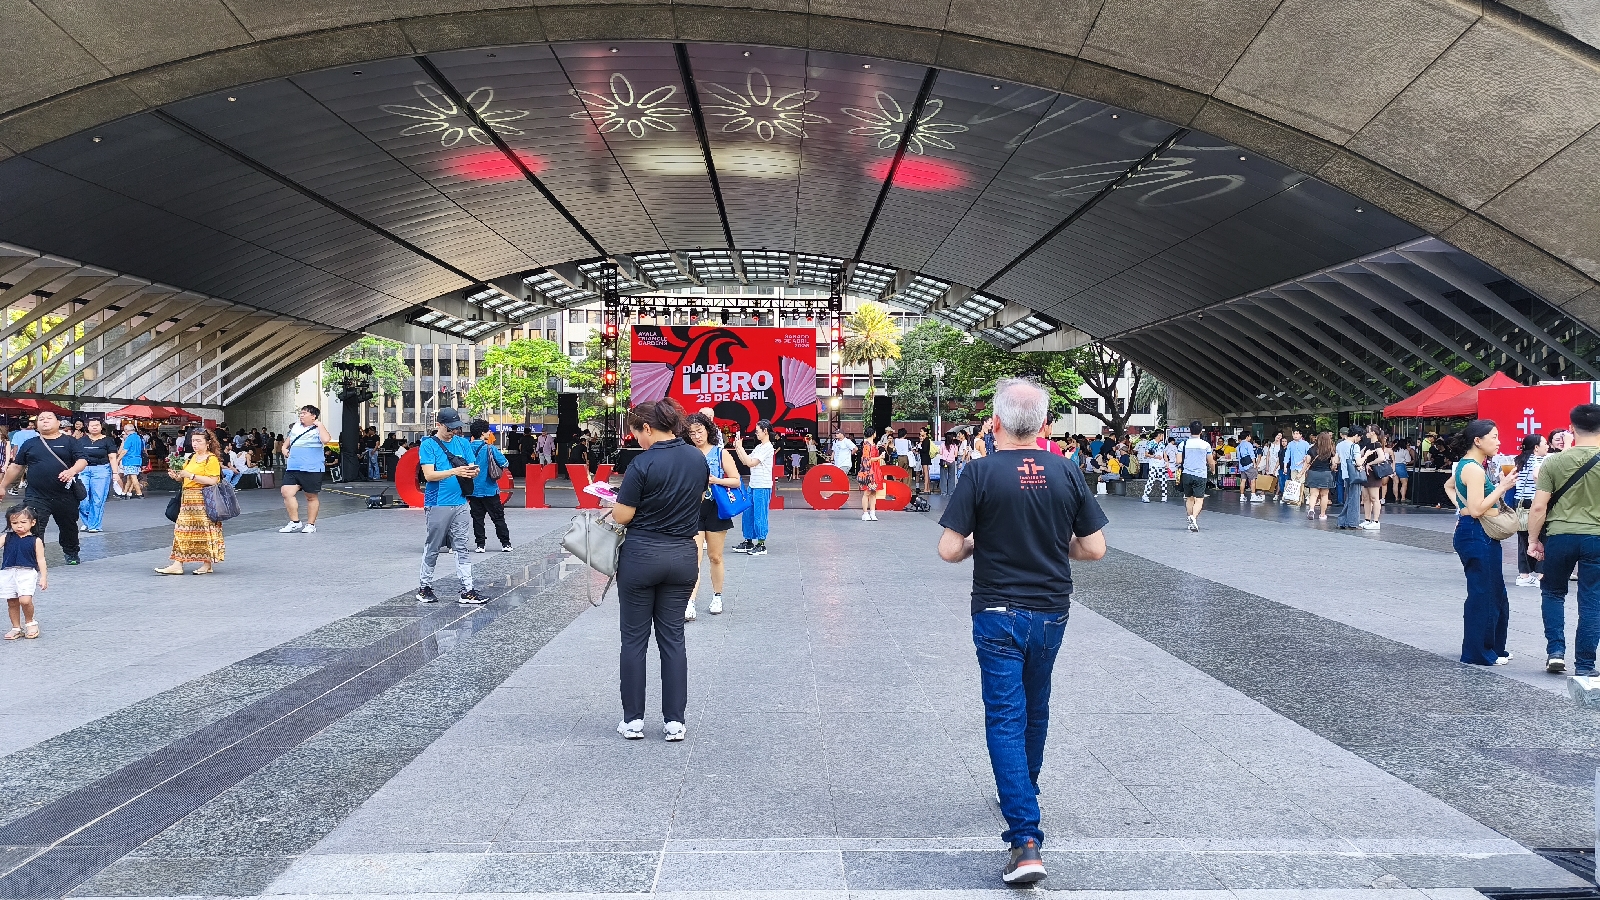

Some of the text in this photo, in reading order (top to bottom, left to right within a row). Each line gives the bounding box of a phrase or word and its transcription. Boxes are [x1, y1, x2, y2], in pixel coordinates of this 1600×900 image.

[682, 362, 730, 374] DÍA DEL
[682, 370, 774, 395] LIBRO
[695, 390, 769, 403] 25 DE ABRIL
[395, 446, 912, 511] Crves
